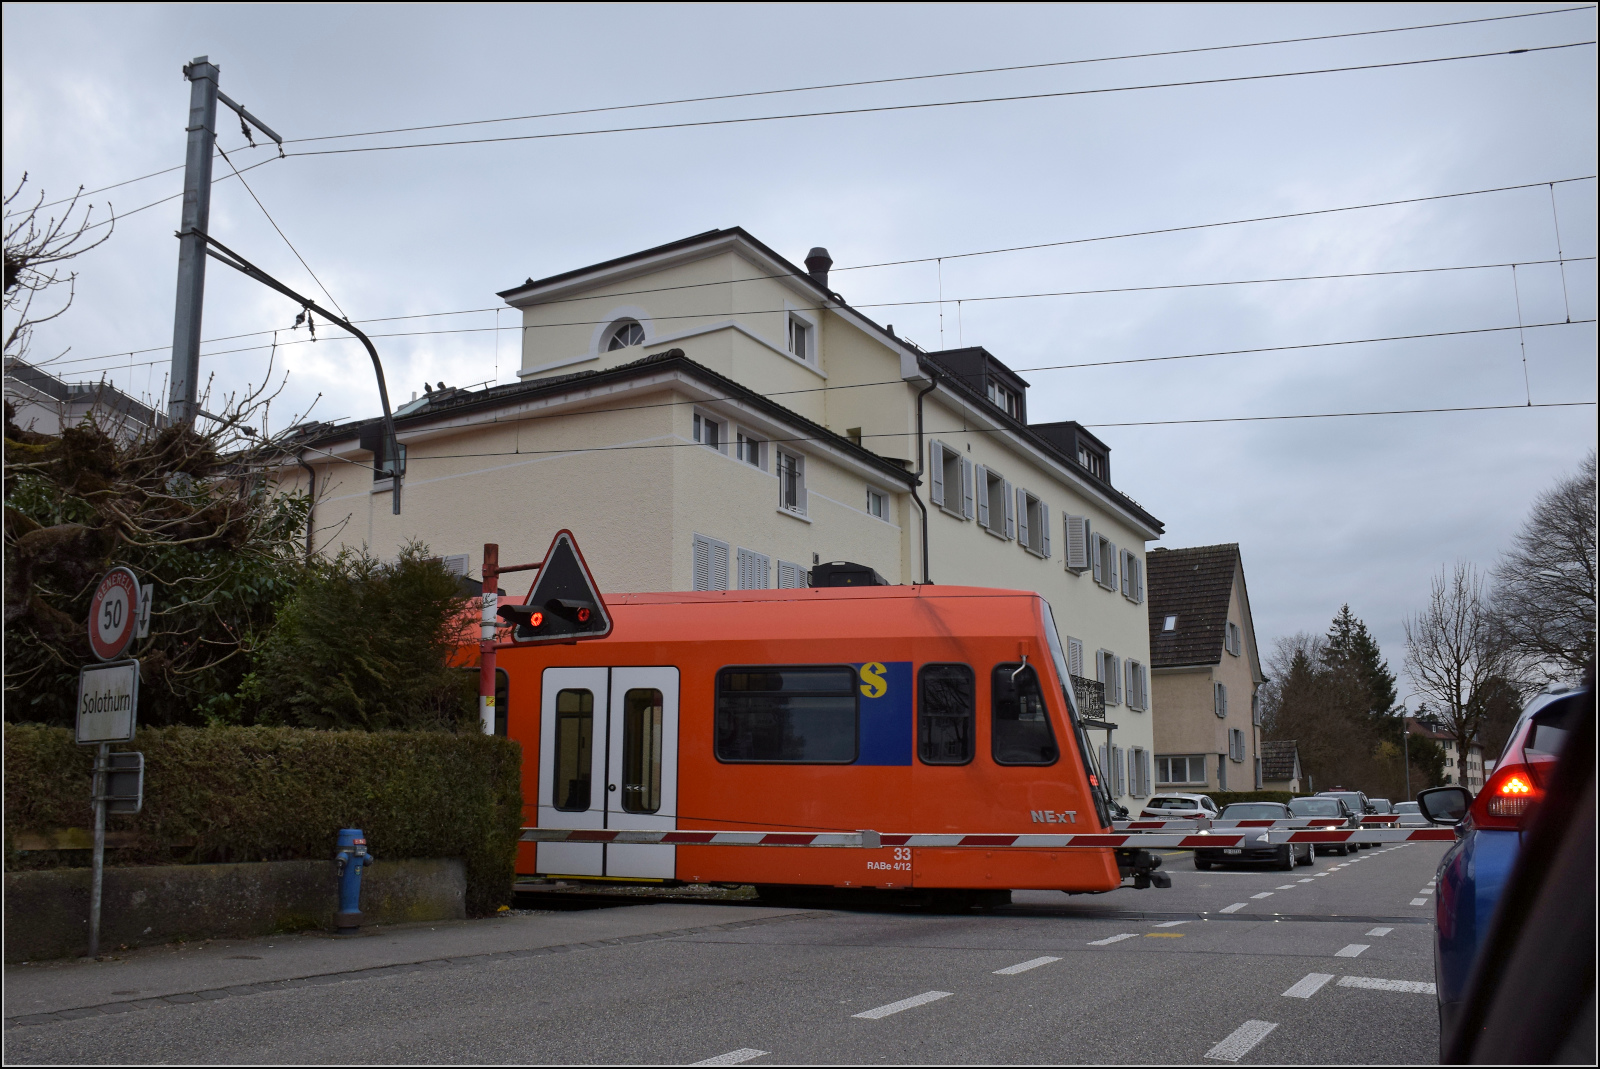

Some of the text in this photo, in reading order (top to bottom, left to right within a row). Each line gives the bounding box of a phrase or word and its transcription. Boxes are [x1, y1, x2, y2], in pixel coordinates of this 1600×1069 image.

[97, 573, 131, 601] GENERELL
[104, 599, 122, 630] 50
[860, 662, 888, 699] S
[82, 690, 131, 715] Solothurn
[1030, 810, 1078, 824] NExT
[867, 861, 912, 871] RABe 4/12
[893, 848, 912, 861] 33
